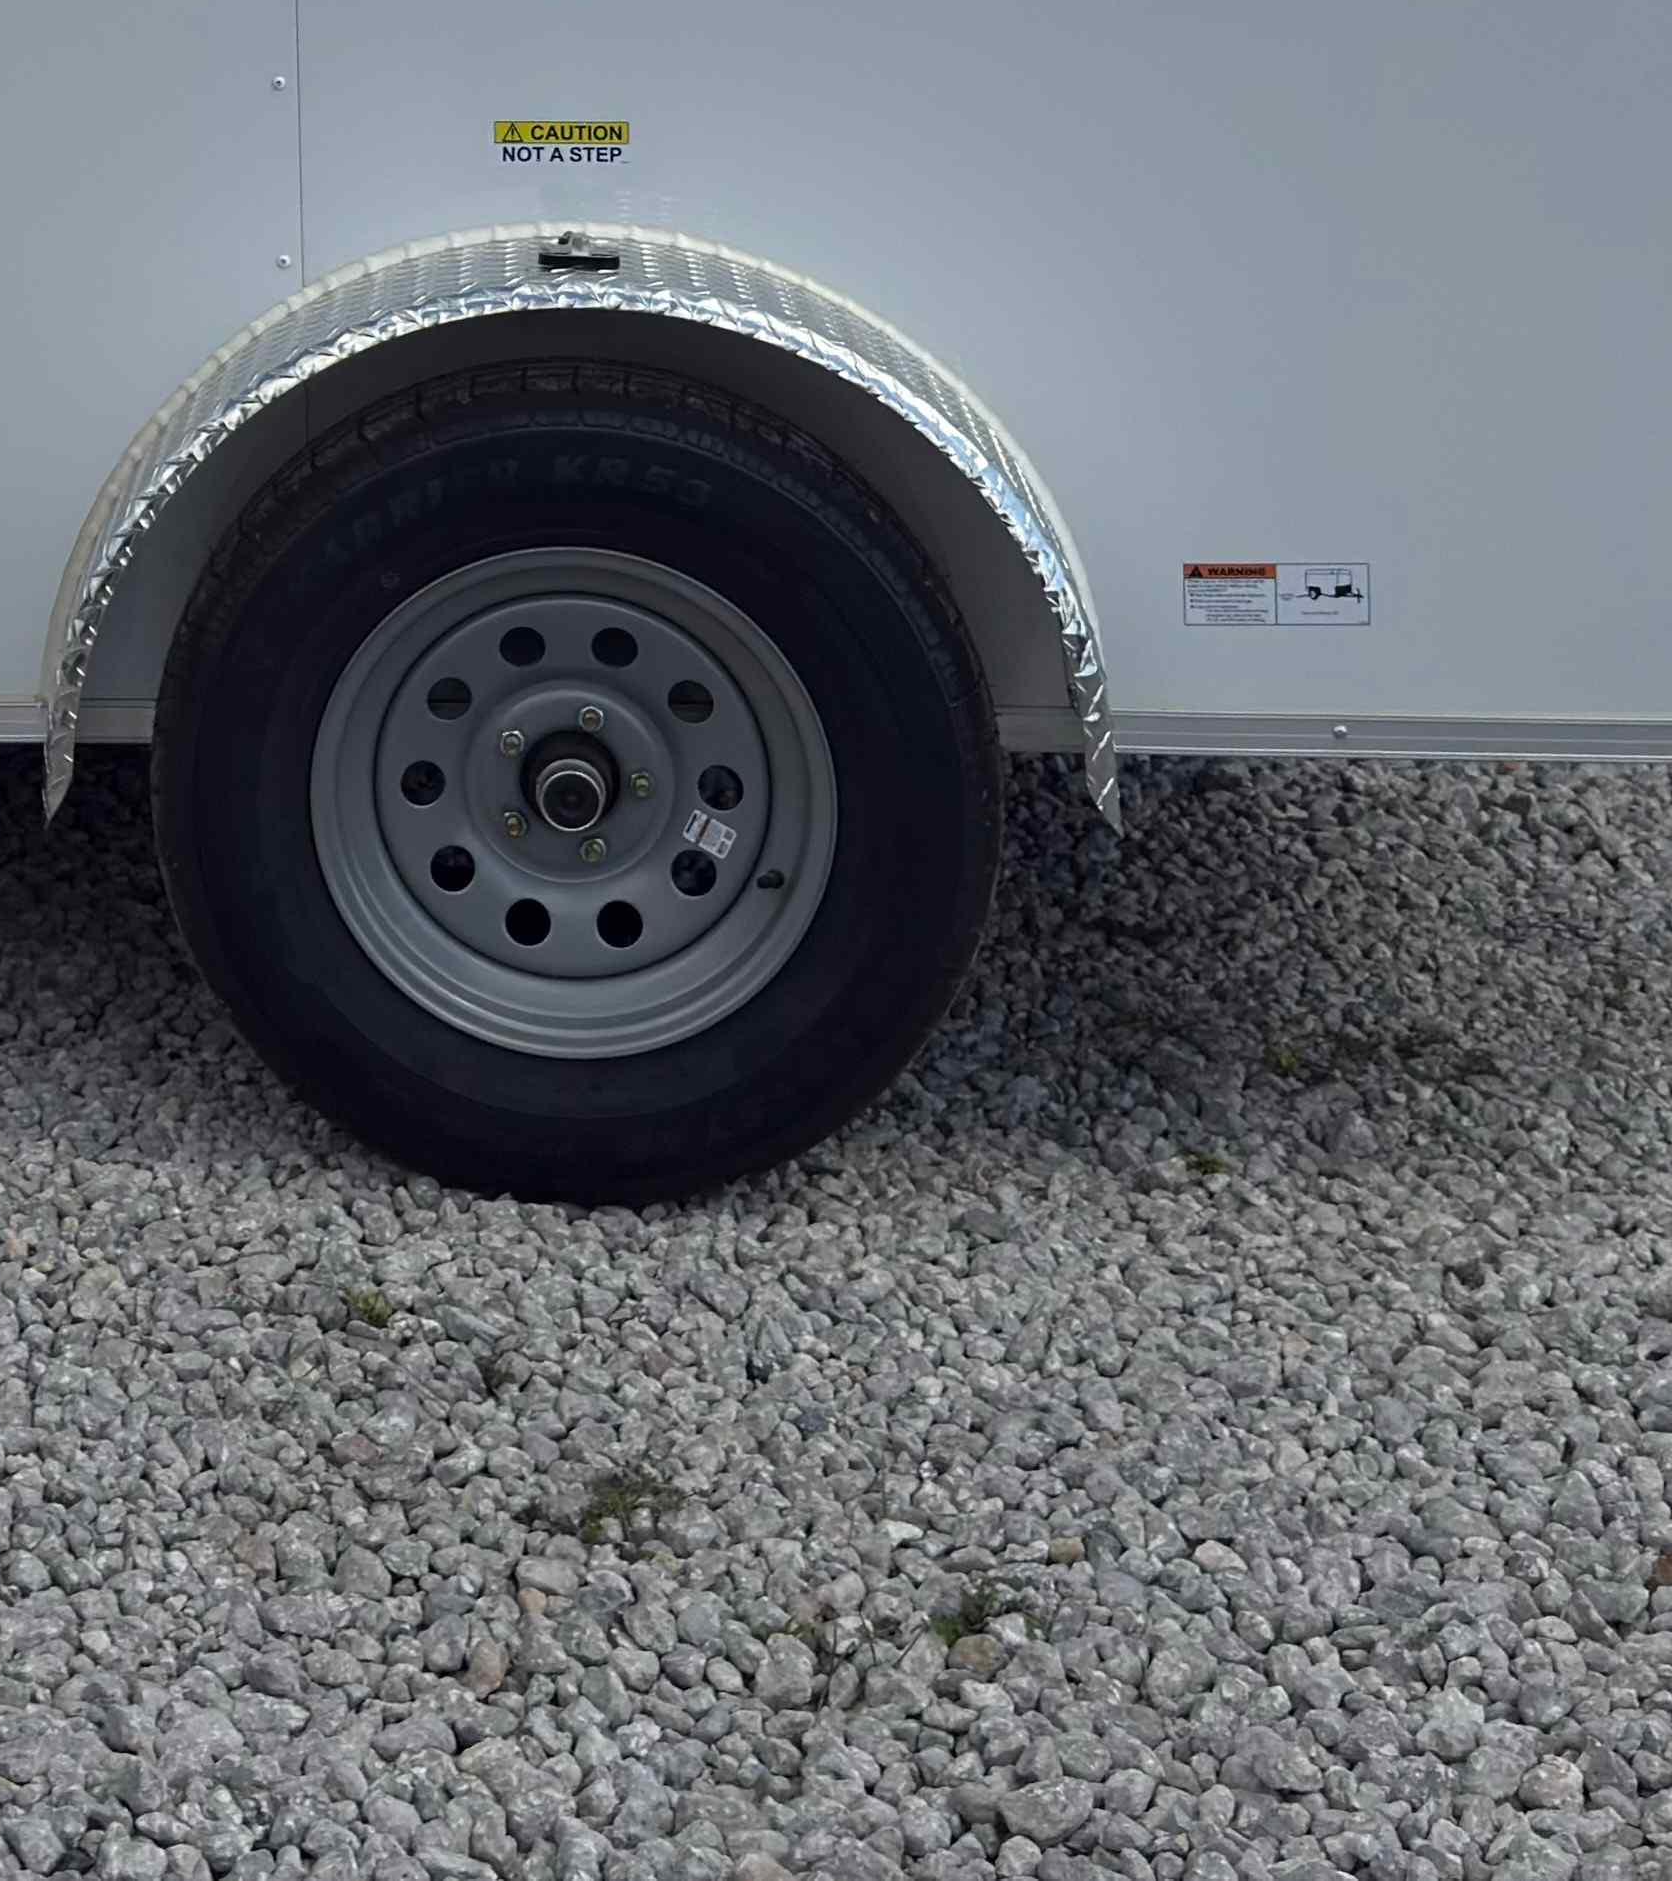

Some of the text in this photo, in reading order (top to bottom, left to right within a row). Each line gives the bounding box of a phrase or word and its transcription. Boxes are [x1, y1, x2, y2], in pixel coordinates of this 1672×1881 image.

[530, 124, 623, 141] CAUTION
[502, 146, 622, 162] NOT A STEP
